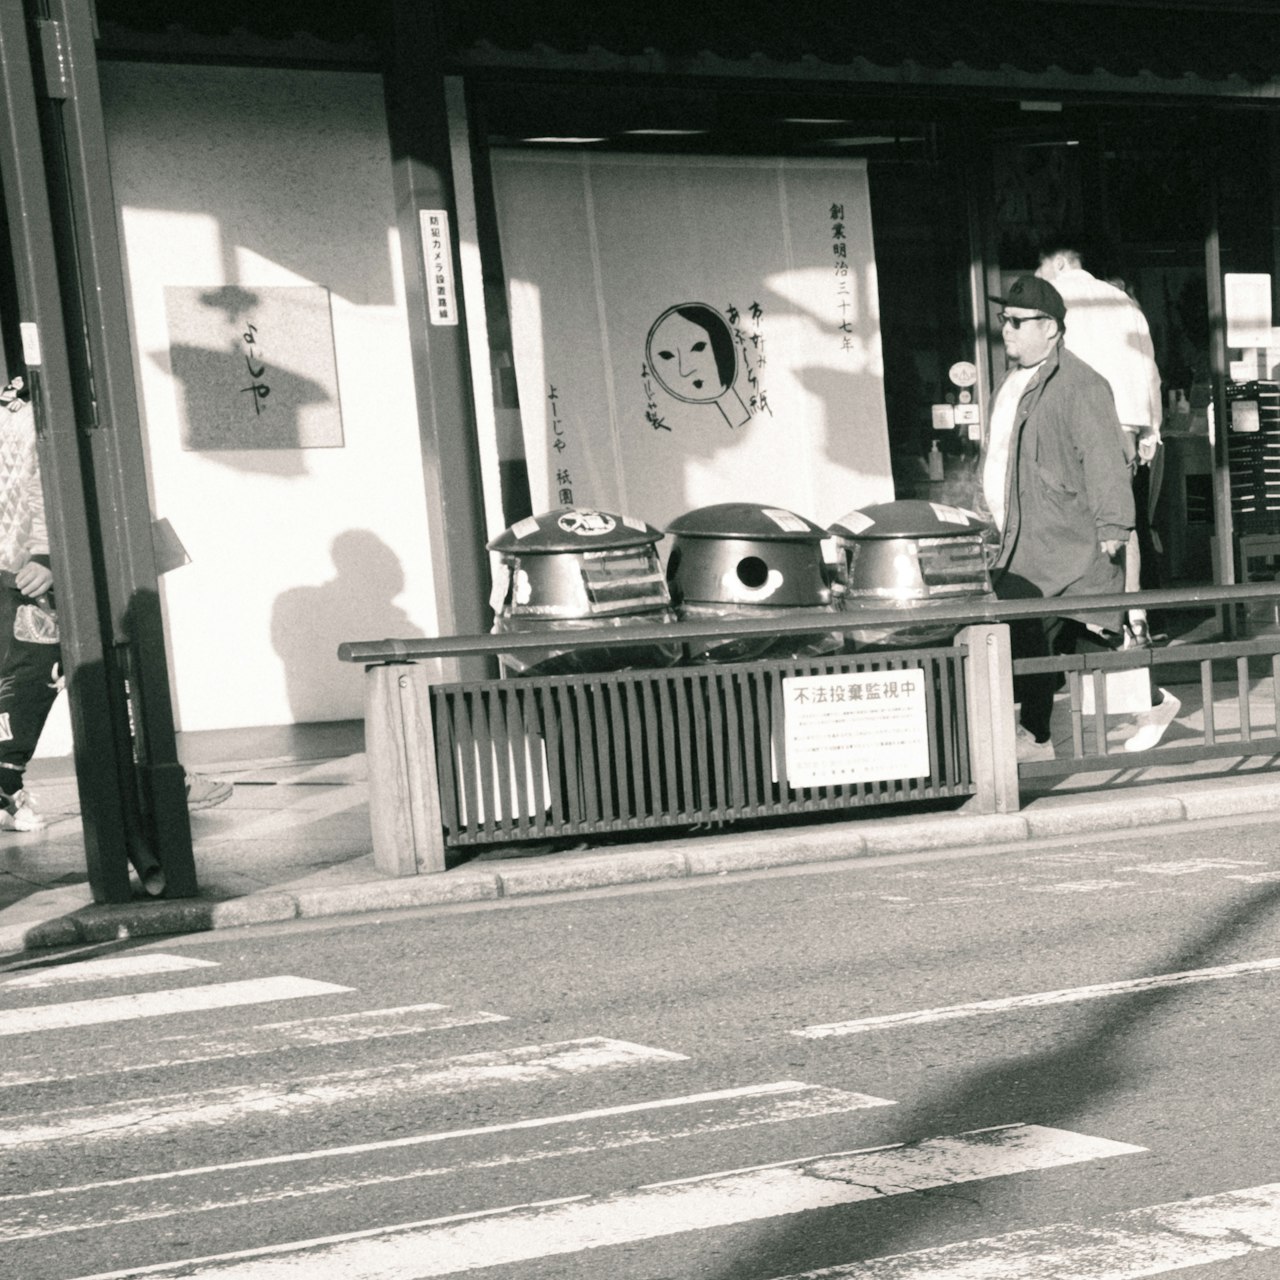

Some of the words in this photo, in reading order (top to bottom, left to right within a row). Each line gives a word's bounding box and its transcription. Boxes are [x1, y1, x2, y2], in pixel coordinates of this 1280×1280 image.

[829, 203, 854, 352] 創業明治三十七年
[547, 384, 566, 454] よーじや
[556, 468, 574, 510] 祇園
[793, 680, 917, 704] 不法投棄監視中
